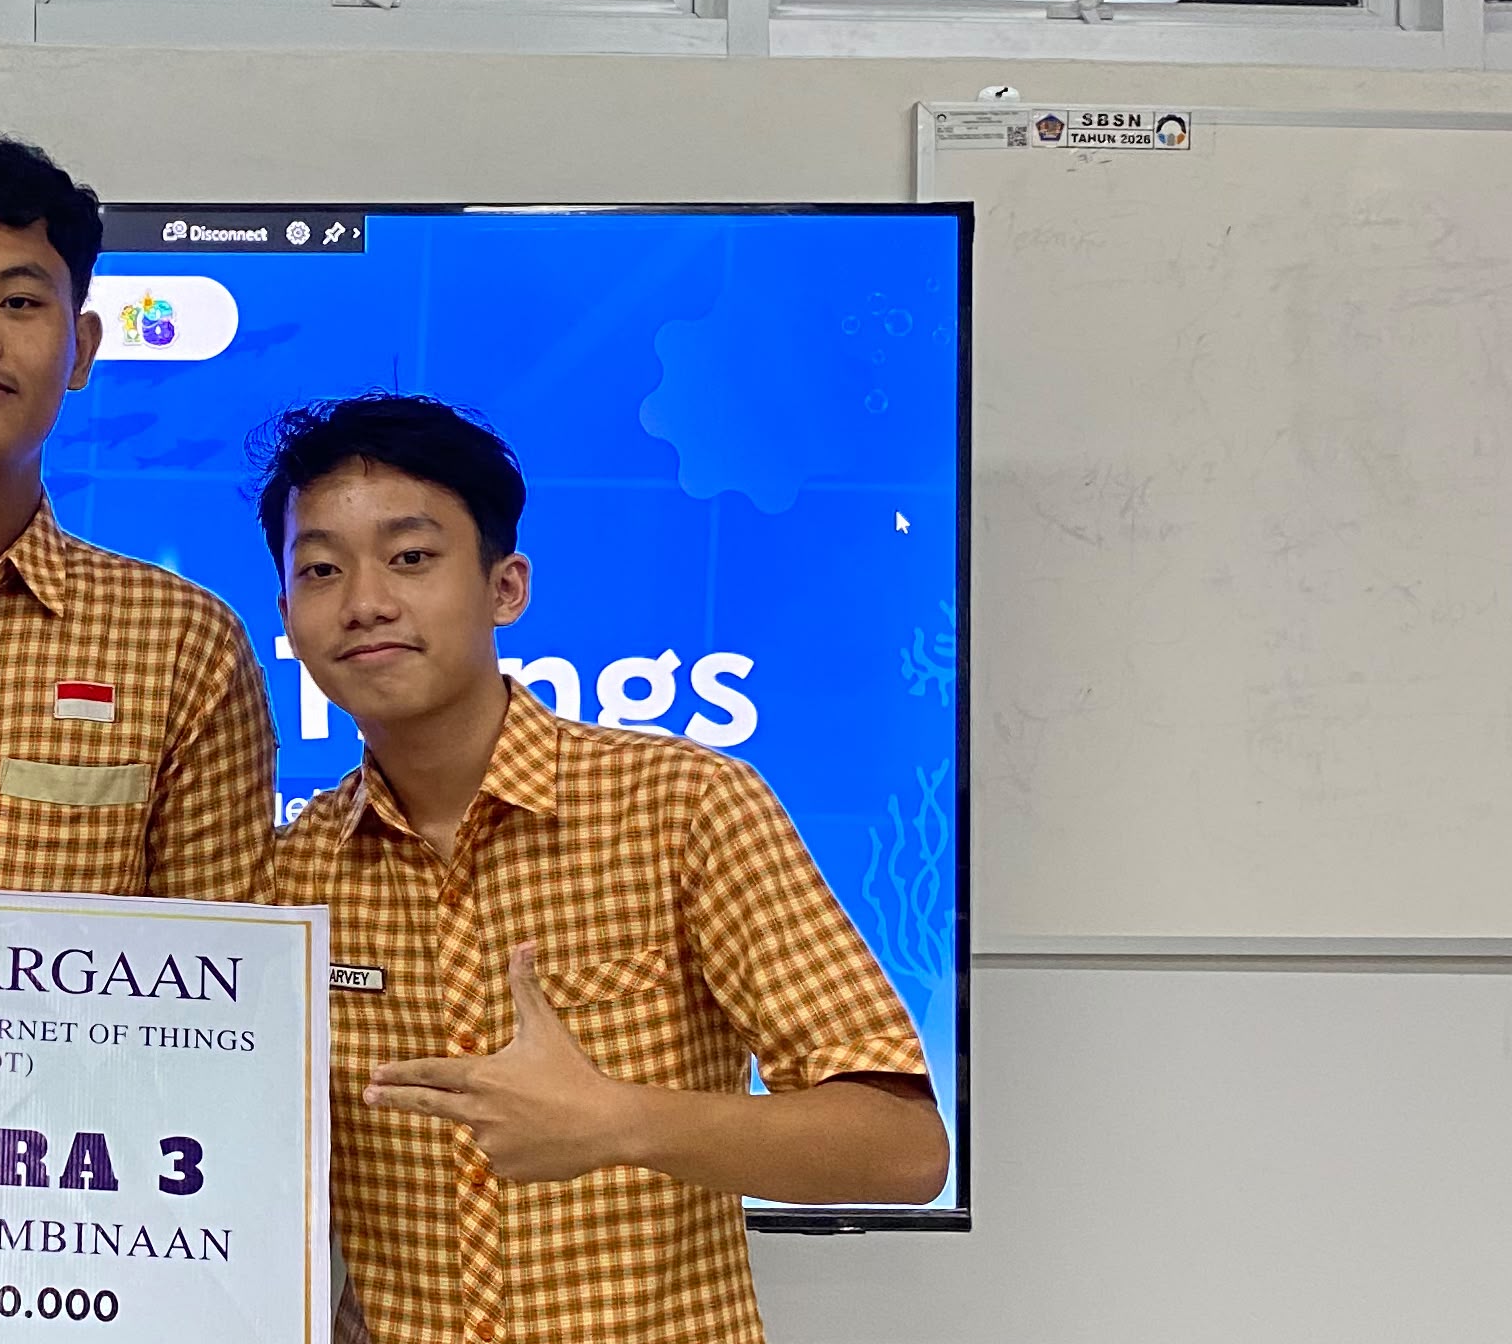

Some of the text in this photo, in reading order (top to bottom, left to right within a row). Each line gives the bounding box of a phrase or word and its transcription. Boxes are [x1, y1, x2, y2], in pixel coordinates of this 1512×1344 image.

[1081, 112, 1142, 127] SBSN
[1070, 133, 1116, 144] TAHUN
[190, 224, 268, 242] Disconnect
[274, 636, 758, 747] Tngs
[329, 968, 370, 986] ARVEY
[90, 1024, 129, 1045] OF
[139, 1025, 257, 1053] THINGS
[158, 1136, 205, 1196] 3
